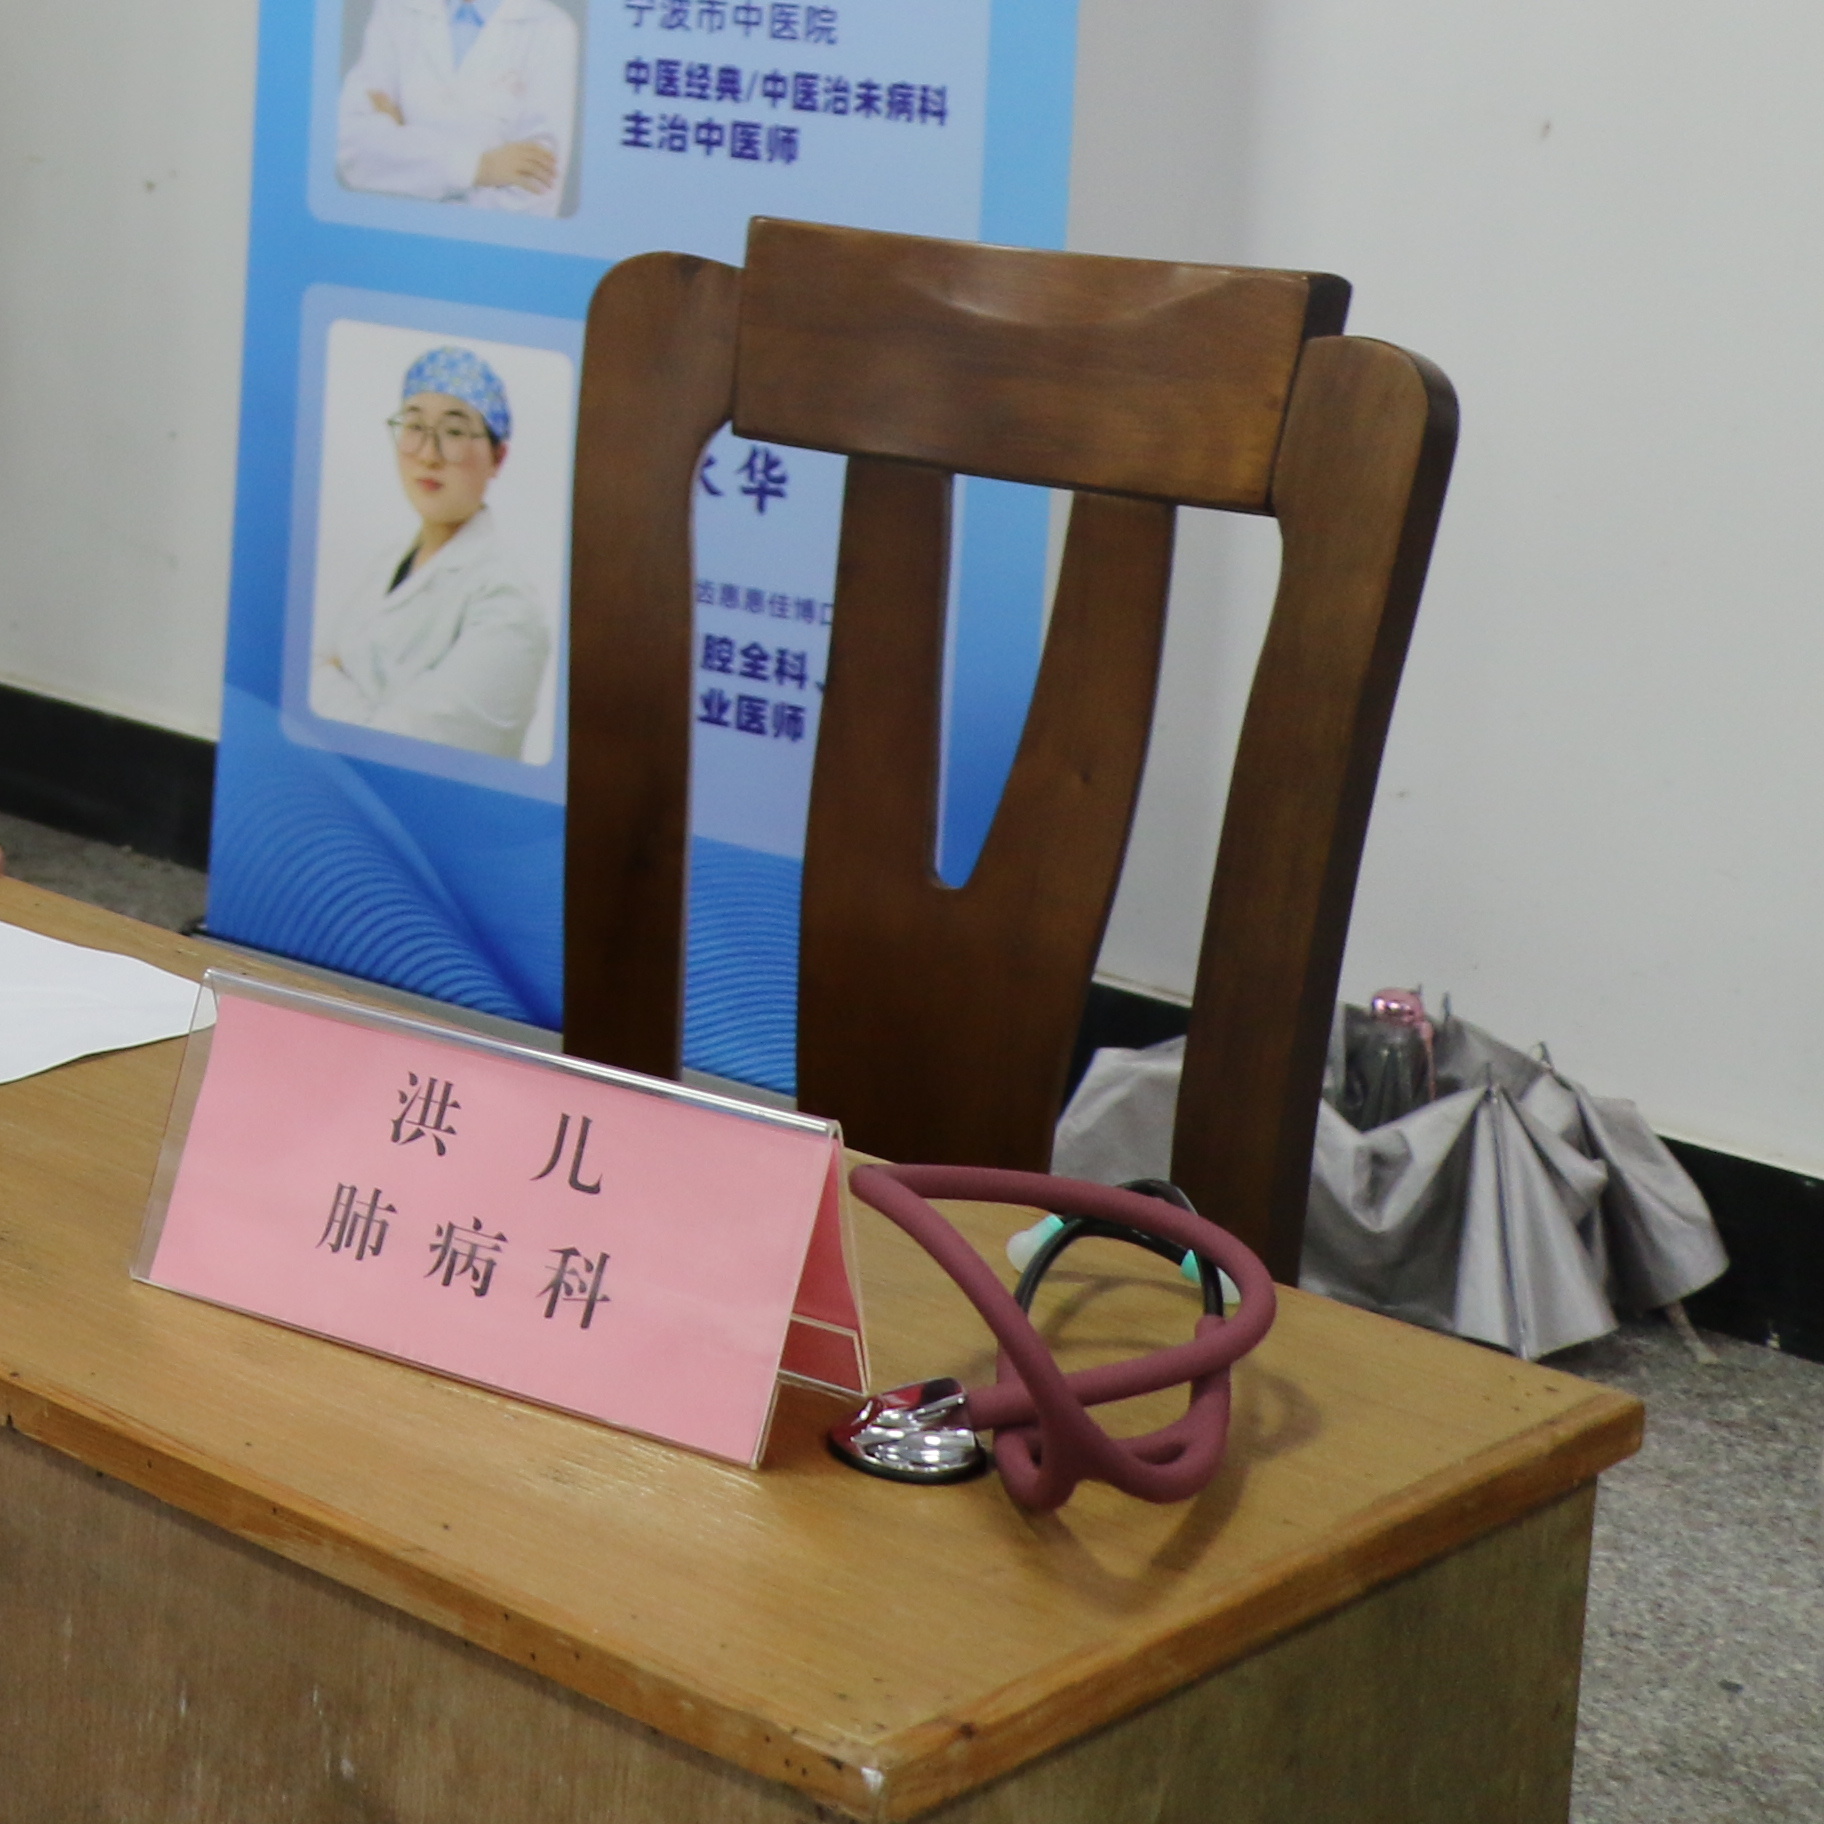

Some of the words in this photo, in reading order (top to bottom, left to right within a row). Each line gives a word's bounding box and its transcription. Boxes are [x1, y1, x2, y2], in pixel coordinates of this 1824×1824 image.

[624, 55, 950, 127] 中医经典/中医治未病科
[621, 110, 801, 165] 主治中医师
[697, 687, 807, 743] 业医师
[388, 1069, 604, 1196] 洪儿
[315, 1182, 613, 1330] 肺病科
